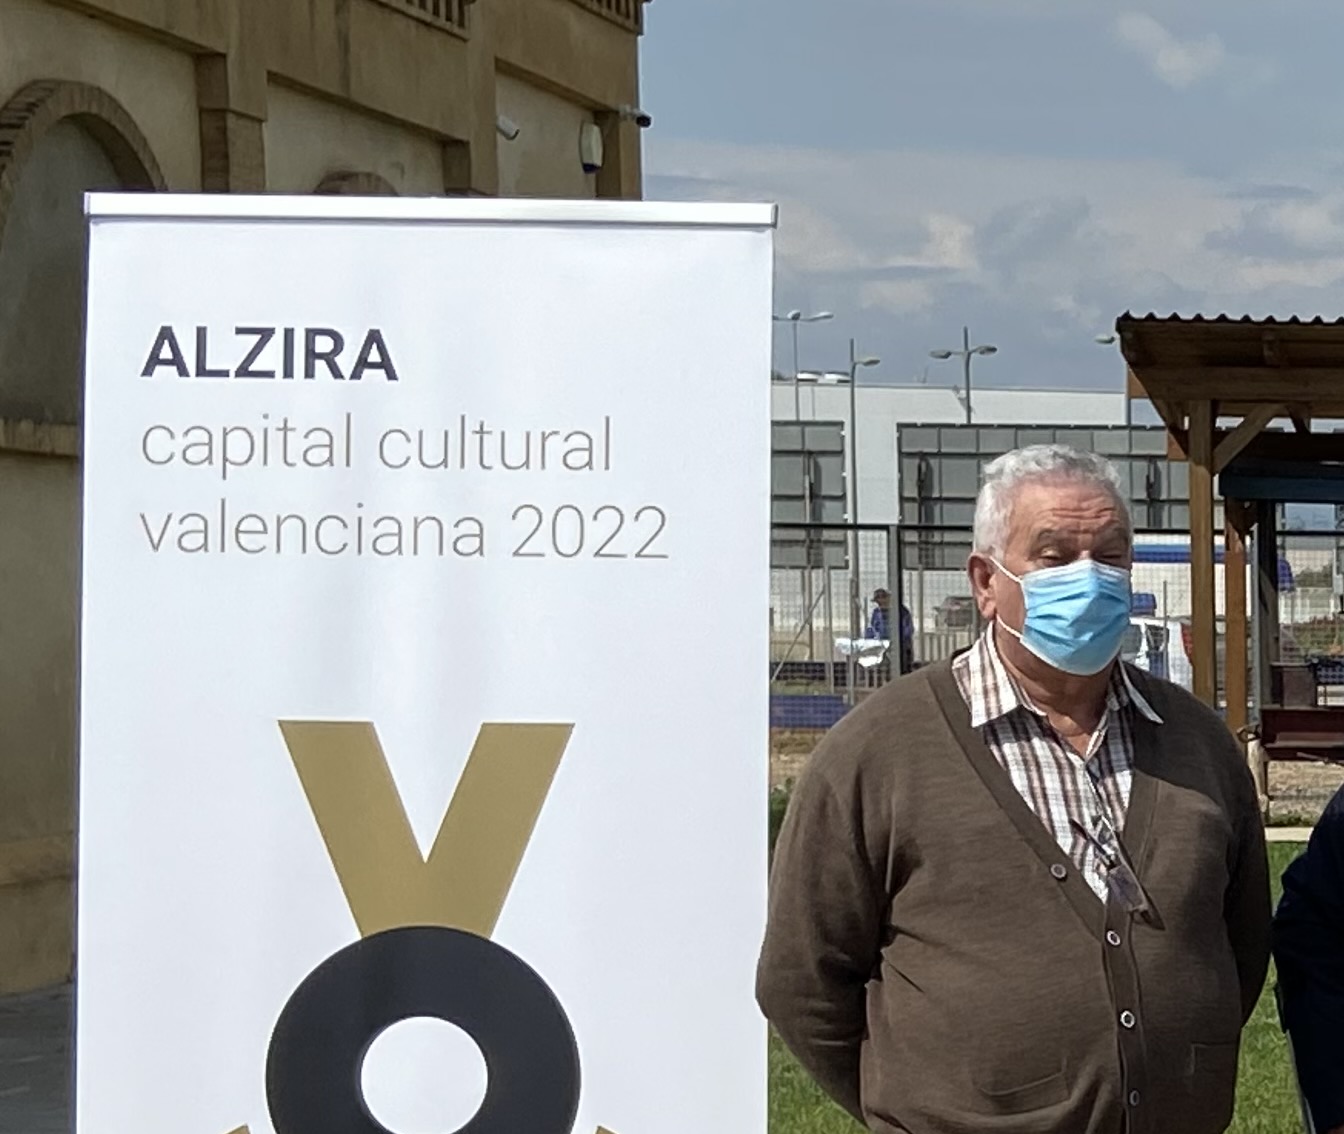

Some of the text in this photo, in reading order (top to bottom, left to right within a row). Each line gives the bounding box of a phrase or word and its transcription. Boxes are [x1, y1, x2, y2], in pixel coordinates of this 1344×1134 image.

[140, 325, 399, 382] ALZIRA
[141, 412, 611, 481] capital cultural
[139, 497, 669, 560] valenciana 2022
